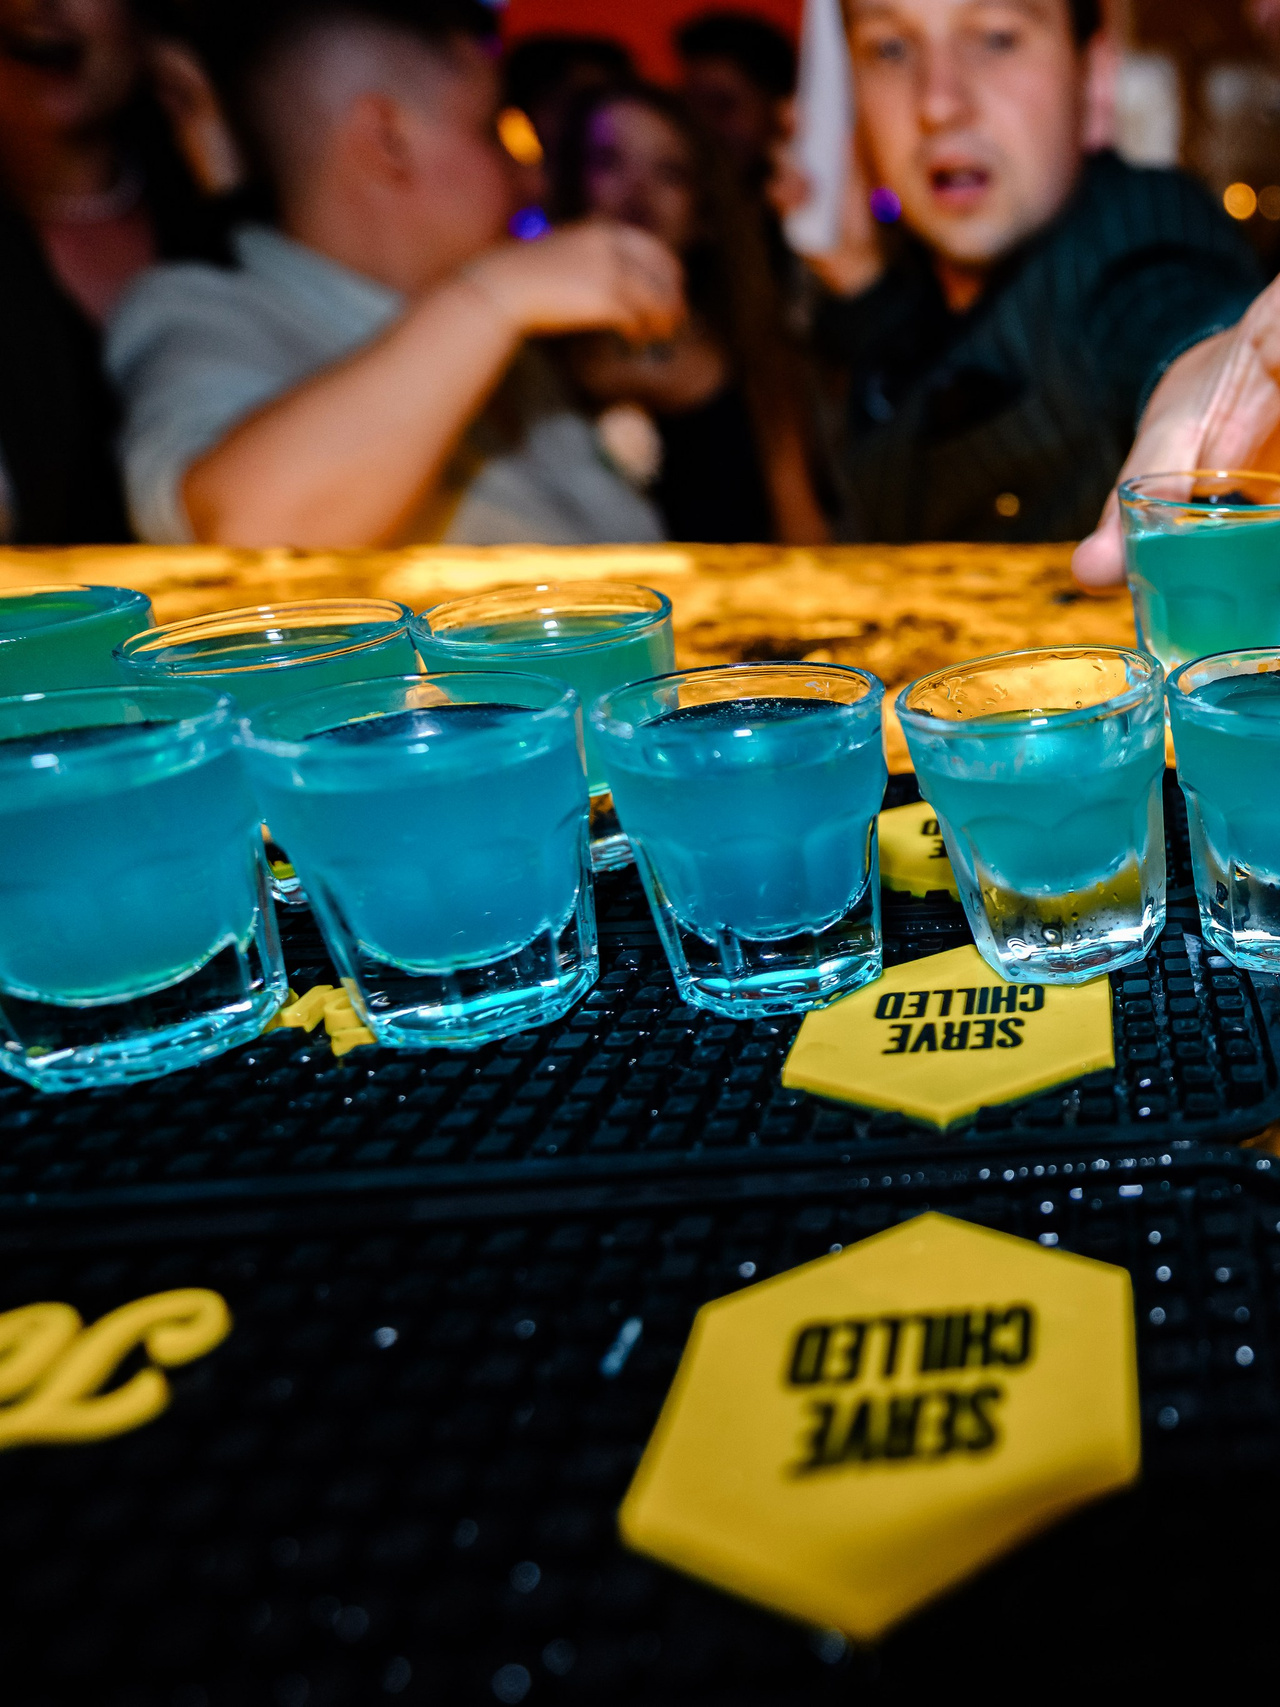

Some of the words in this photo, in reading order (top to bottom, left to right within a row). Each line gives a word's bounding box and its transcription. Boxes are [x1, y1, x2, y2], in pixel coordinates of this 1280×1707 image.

[875, 984, 1044, 1020] CHILLED
[881, 1018, 1025, 1054] SERVE
[785, 1303, 1036, 1386] CHILLED
[791, 1386, 1003, 1478] SERVE
